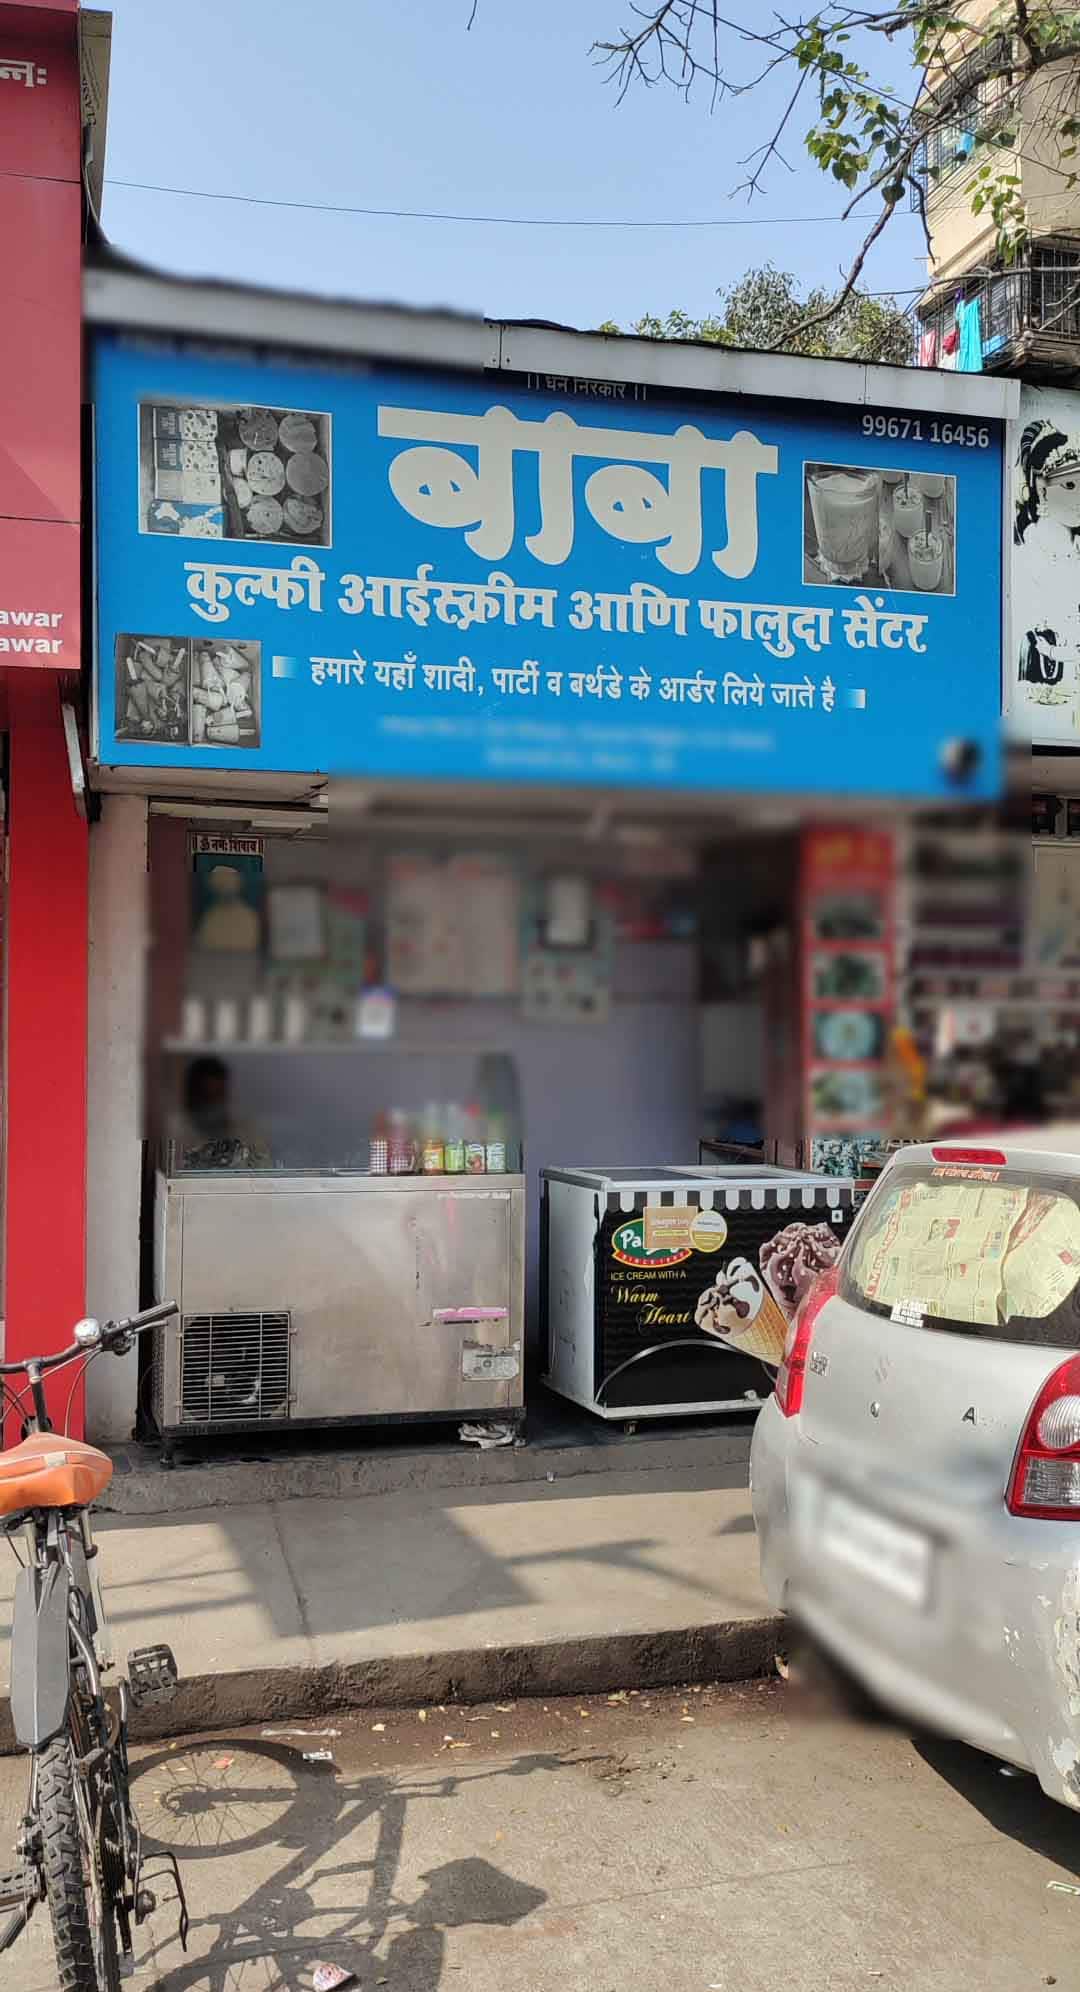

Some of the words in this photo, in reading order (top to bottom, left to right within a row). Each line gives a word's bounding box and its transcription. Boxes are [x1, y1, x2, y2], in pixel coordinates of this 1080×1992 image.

[862, 414, 923, 441] 99671
[930, 422, 990, 448] 16456
[377, 405, 779, 579] बाबा
[183, 555, 326, 623] कुल्फी
[568, 582, 690, 637] आणि
[698, 599, 834, 658] फालुदा
[842, 595, 929, 654] सेंटर
[309, 649, 367, 686] हमारे
[372, 651, 417, 691] यहाँ
[422, 656, 485, 696] शादी,
[491, 660, 541, 697] पार्टी
[546, 672, 564, 697] व
[568, 665, 623, 699] बर्थडे
[629, 667, 652, 700] के
[658, 670, 717, 705] आर्डर
[722, 671, 766, 706] लिये
[770, 675, 815, 708] जाते
[820, 675, 836, 712] है
[610, 1271, 625, 1281] ICE
[626, 1270, 656, 1280] CREAM
[658, 1270, 679, 1280] WITH
[680, 1269, 687, 1278] A
[611, 1284, 659, 1304] Warm
[636, 1303, 690, 1325] Heart
